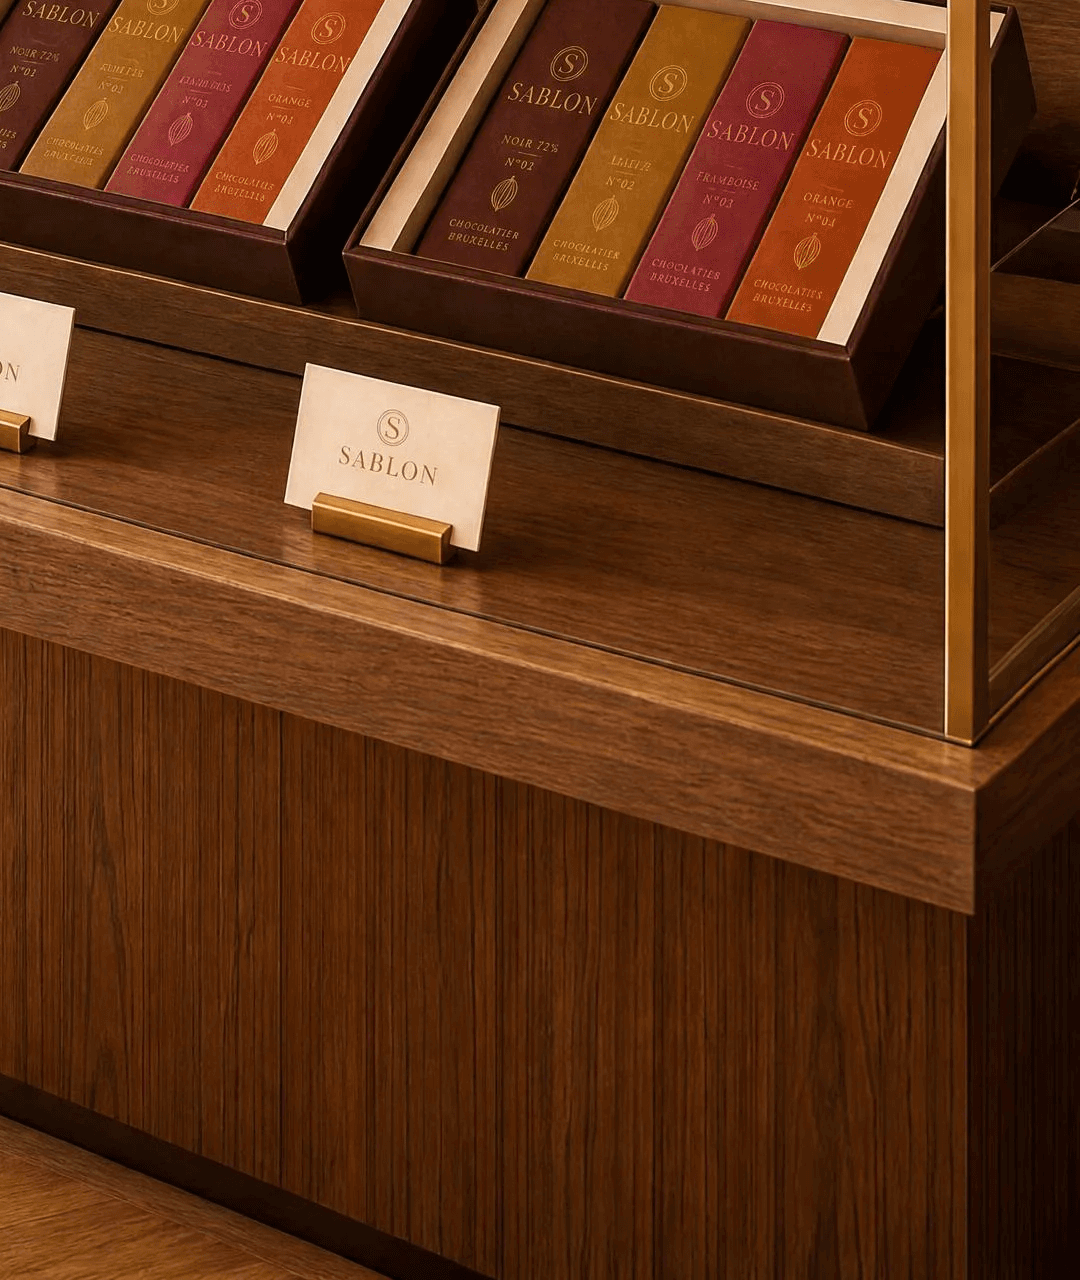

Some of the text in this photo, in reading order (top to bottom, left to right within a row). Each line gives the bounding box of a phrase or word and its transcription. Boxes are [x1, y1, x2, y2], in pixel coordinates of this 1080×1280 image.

[23, 1, 101, 28] SABLON
[236, 5, 254, 23] S
[109, 17, 184, 44] SABLON
[319, 19, 338, 37] S
[191, 31, 268, 57] SABLON
[275, 47, 351, 73] SABLON
[559, 54, 578, 74] S
[658, 73, 678, 93] S
[268, 94, 312, 108] ORANGE
[507, 82, 597, 115] SABLON
[754, 90, 775, 111] S
[610, 102, 695, 133] SABLON
[853, 108, 872, 129] S
[501, 135, 559, 152] NOIR 72%
[707, 120, 795, 151] SABLON
[807, 140, 891, 169] SABLON
[696, 171, 759, 190] FRAMBOISE
[703, 194, 734, 208] N°03
[804, 192, 853, 209] ORANGE
[449, 219, 519, 240] CHOCOLATIER
[448, 232, 508, 251] BRUXELLES
[385, 416, 400, 439] S
[339, 446, 438, 485] SABLON
